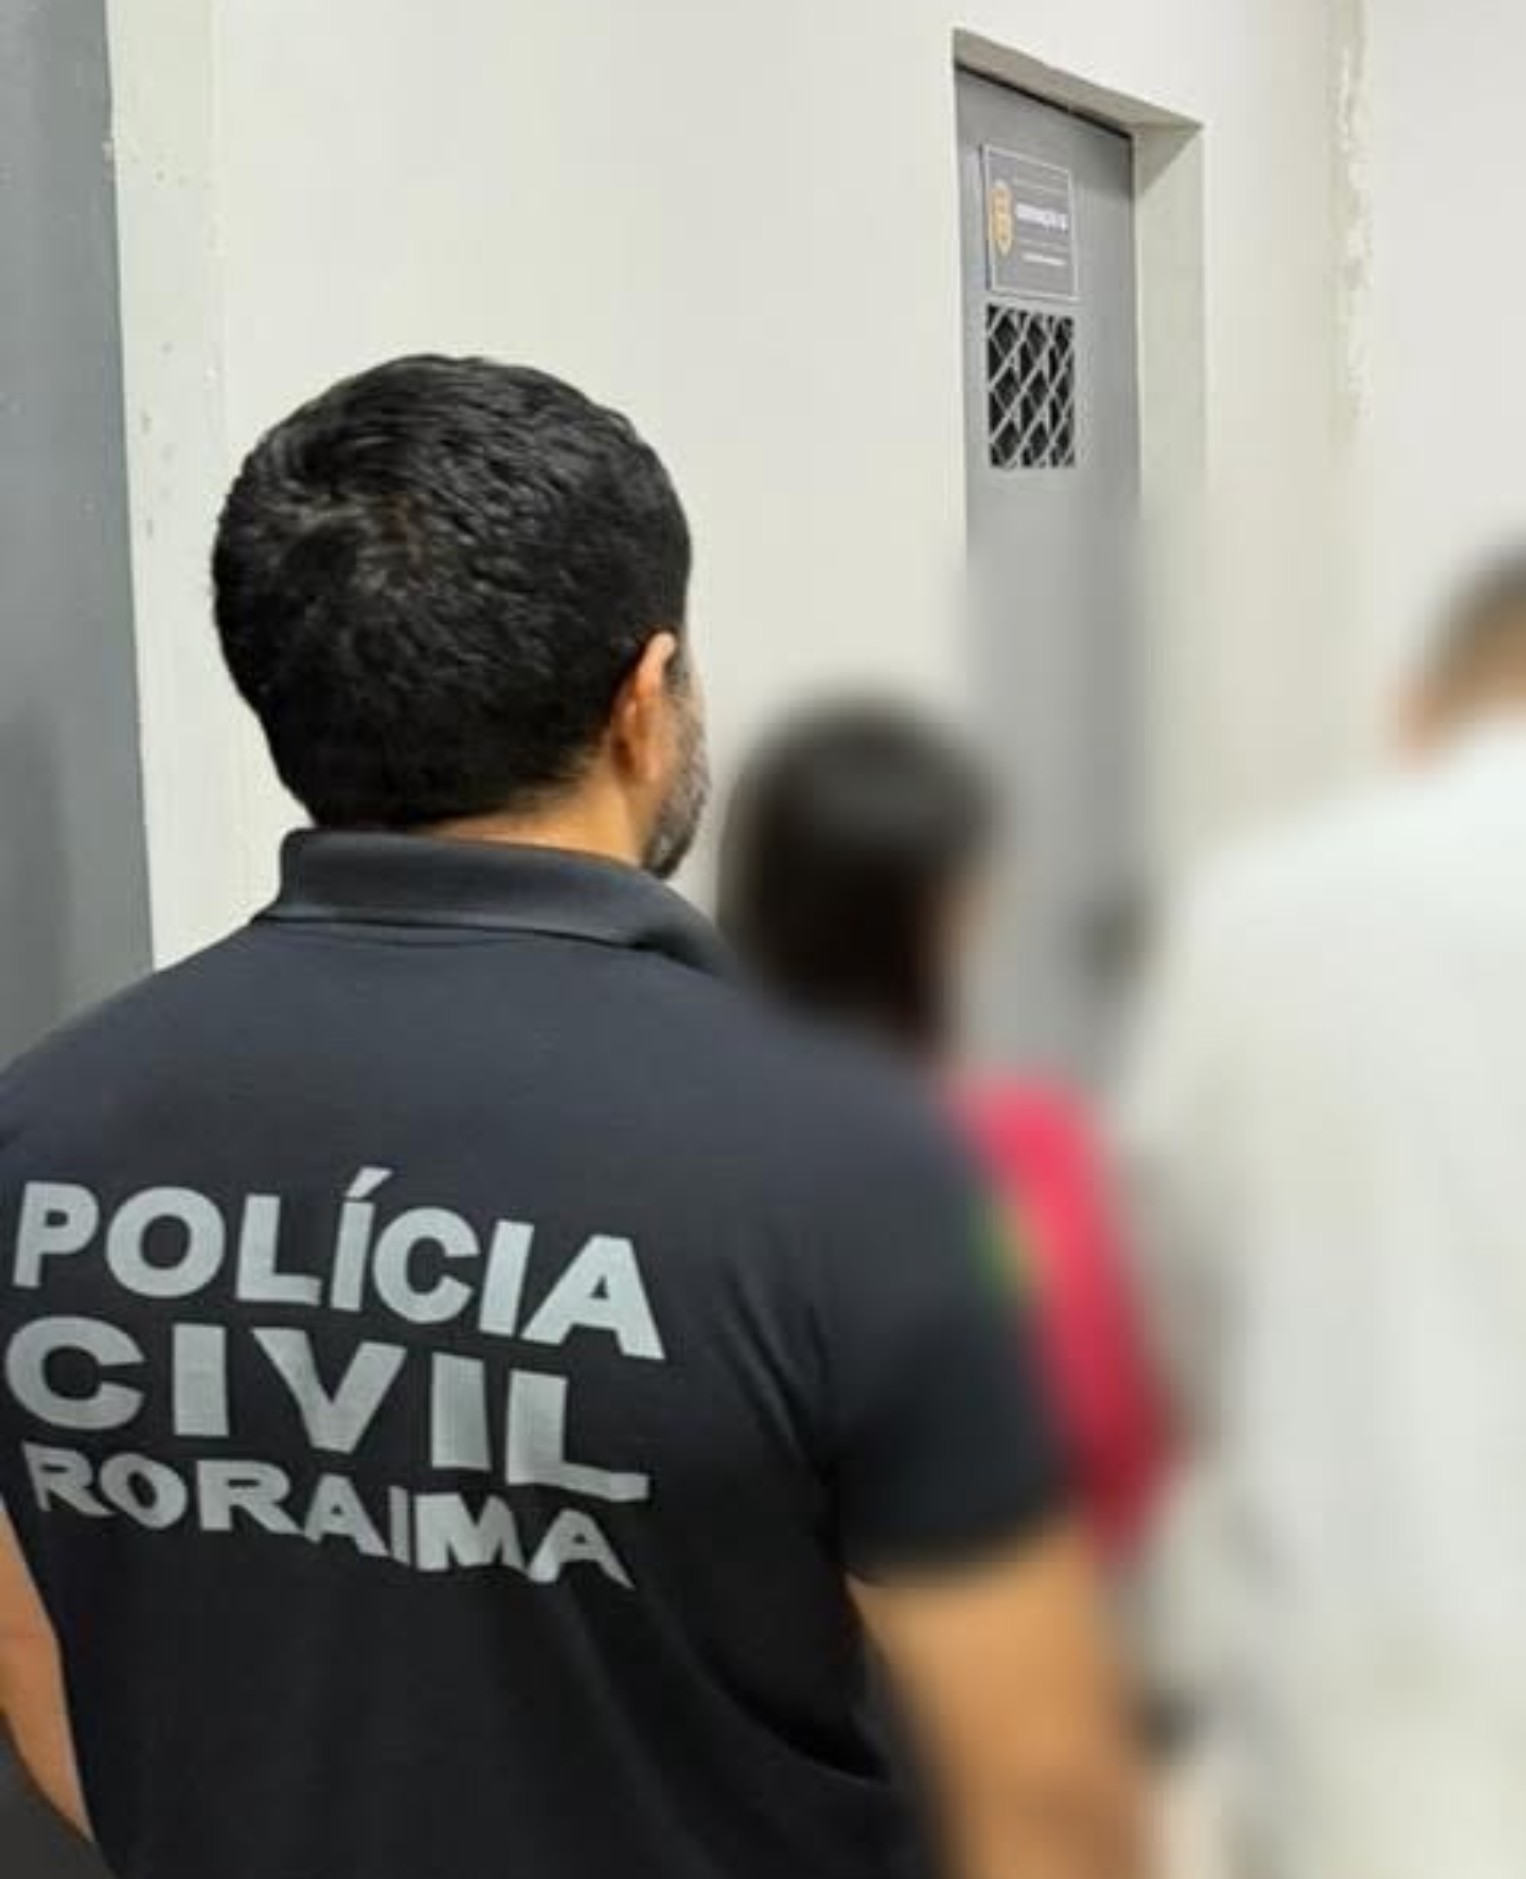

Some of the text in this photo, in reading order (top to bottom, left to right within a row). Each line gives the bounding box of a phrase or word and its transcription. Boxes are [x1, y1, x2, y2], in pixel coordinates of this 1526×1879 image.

[13, 1167, 665, 1360] POLÍCIA
[6, 1315, 650, 1501] CIVIL
[21, 1440, 635, 1589] RORAIMA
